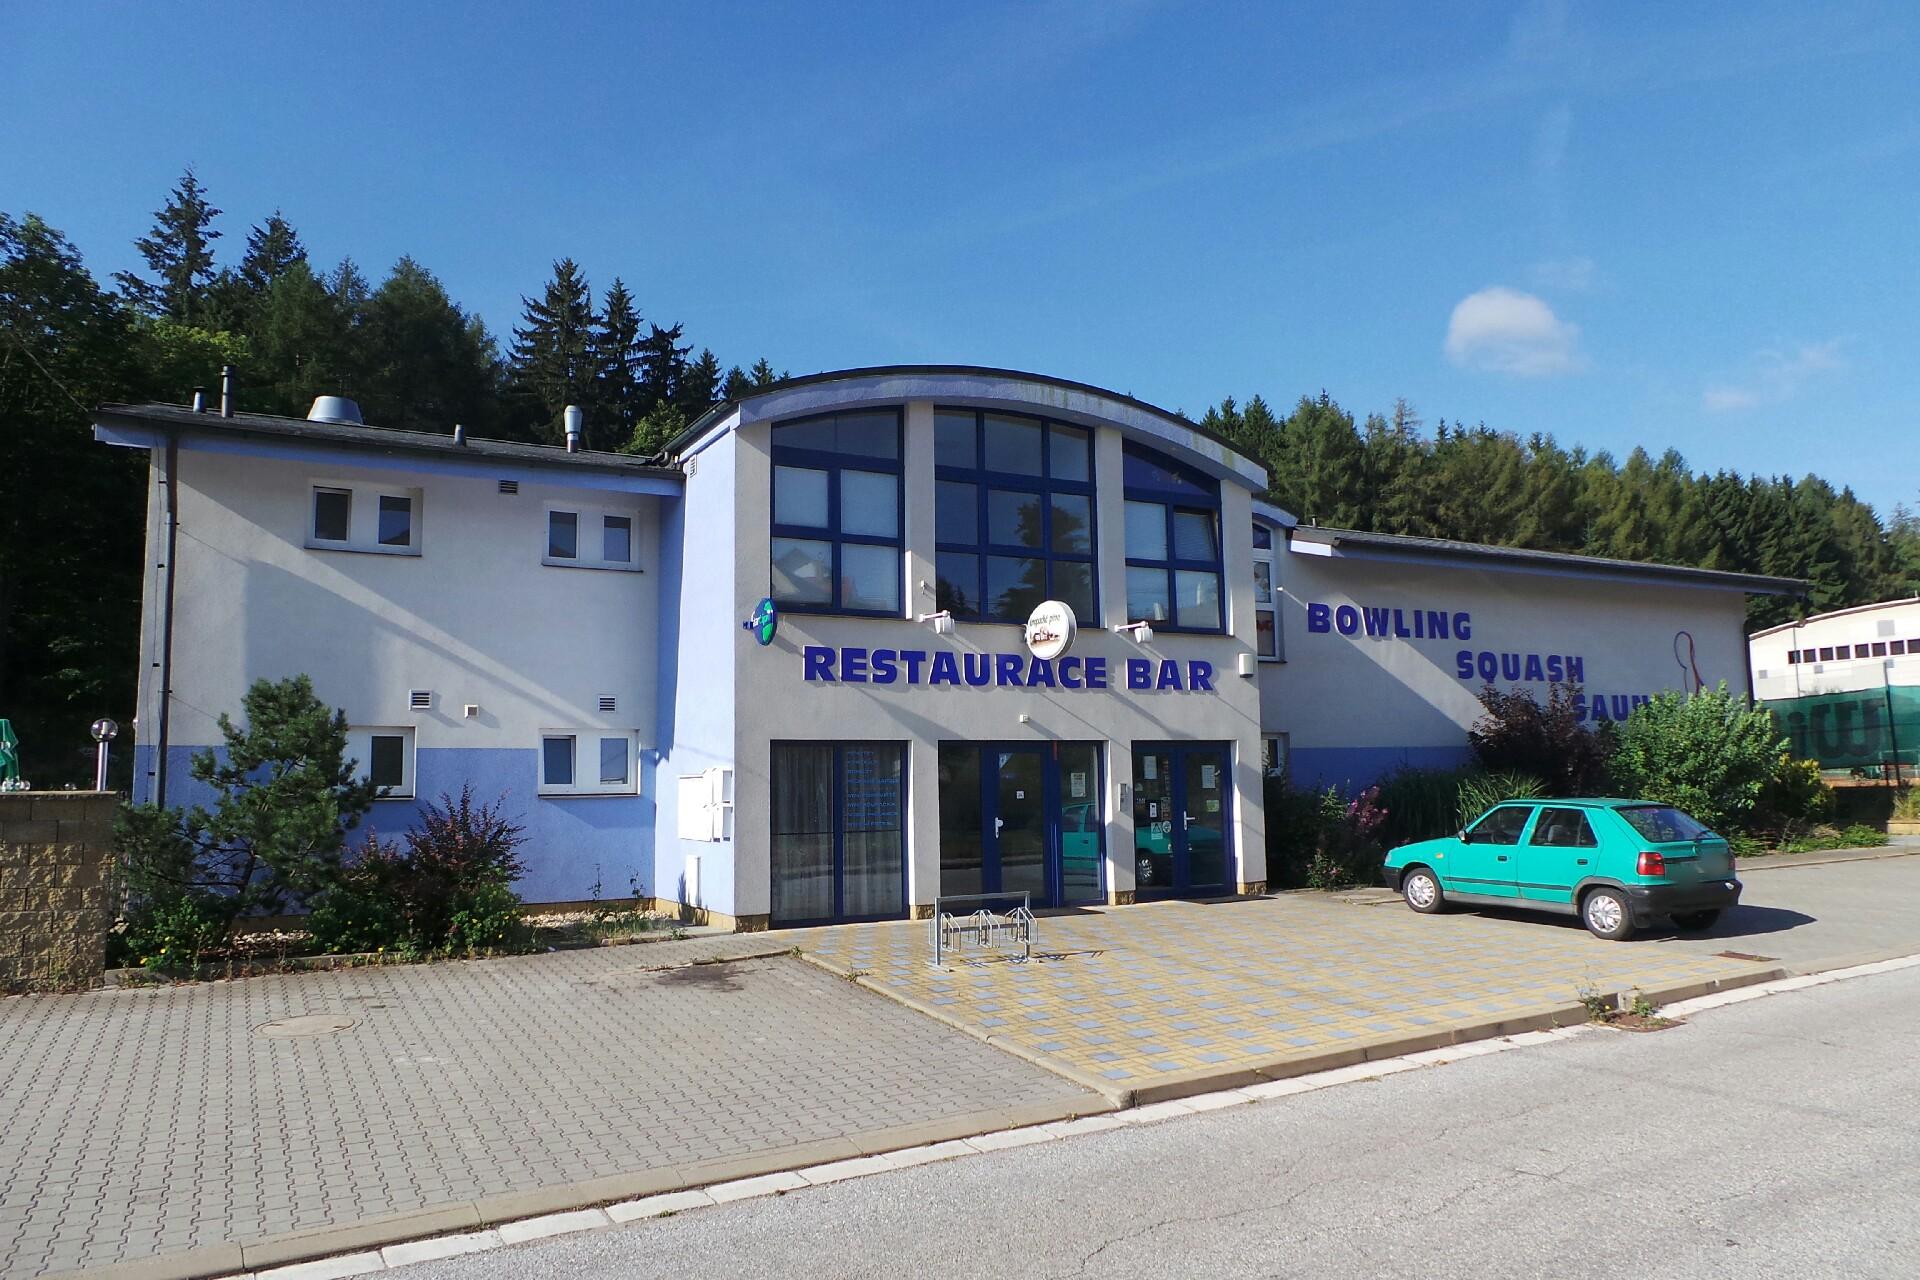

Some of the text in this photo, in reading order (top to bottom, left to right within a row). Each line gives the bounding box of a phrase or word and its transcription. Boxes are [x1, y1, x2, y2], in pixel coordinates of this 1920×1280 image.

[1308, 603, 1472, 640] BOWLING
[804, 645, 1213, 690] RESTAURACE BAR
[1457, 650, 1585, 682] SQUASH
